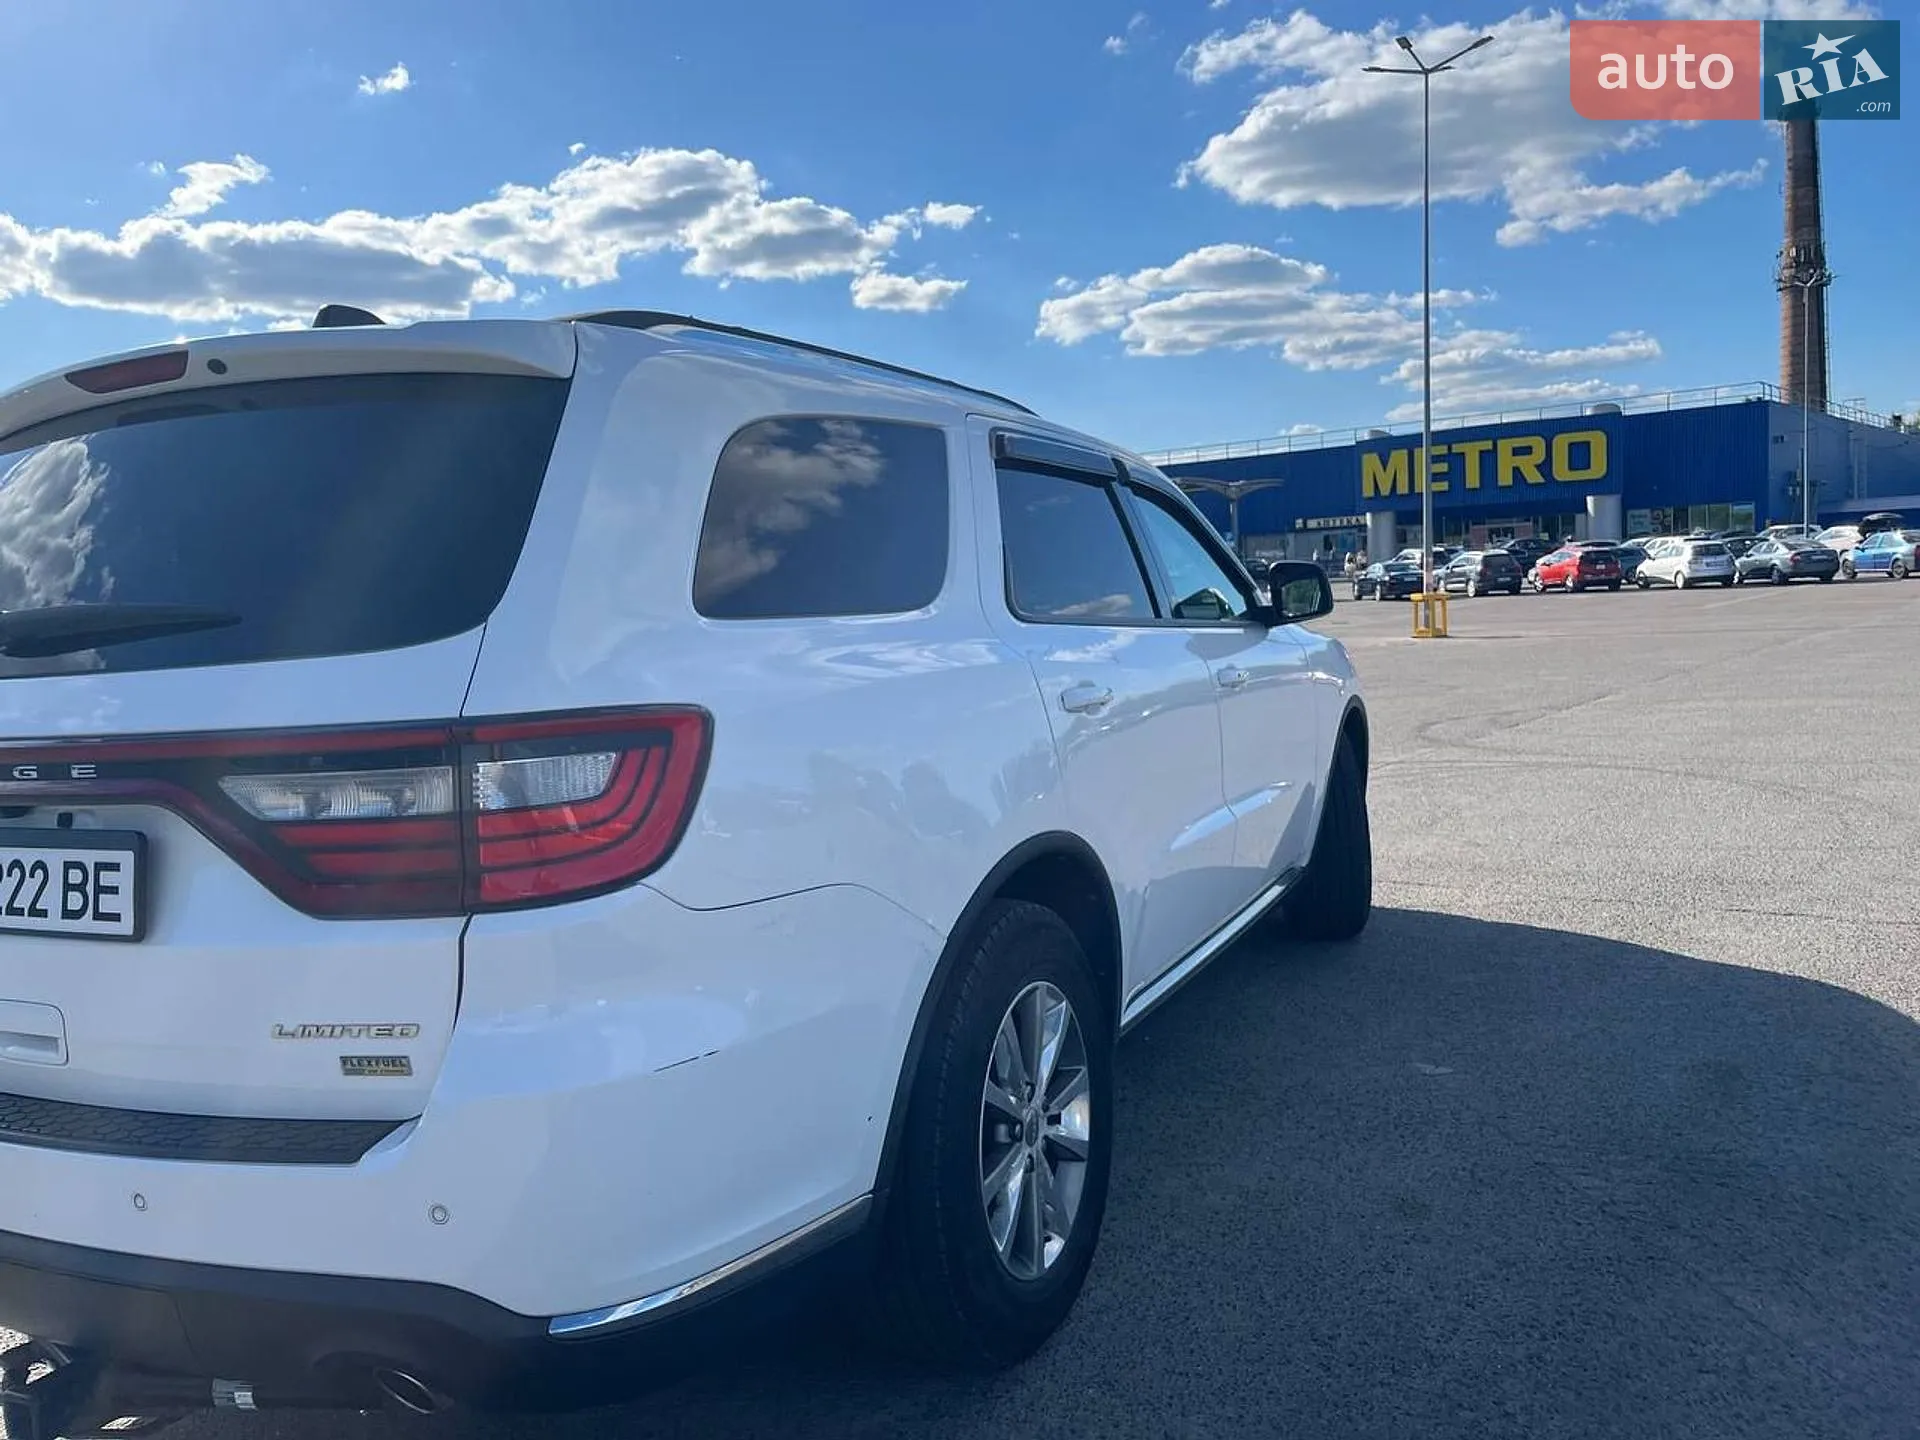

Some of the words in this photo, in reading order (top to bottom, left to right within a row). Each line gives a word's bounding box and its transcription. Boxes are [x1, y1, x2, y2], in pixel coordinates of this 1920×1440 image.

[1362, 430, 1607, 498] METRO
[0, 858, 49, 918] 22
[60, 860, 122, 923] BE
[271, 1023, 420, 1039] LIMITED
